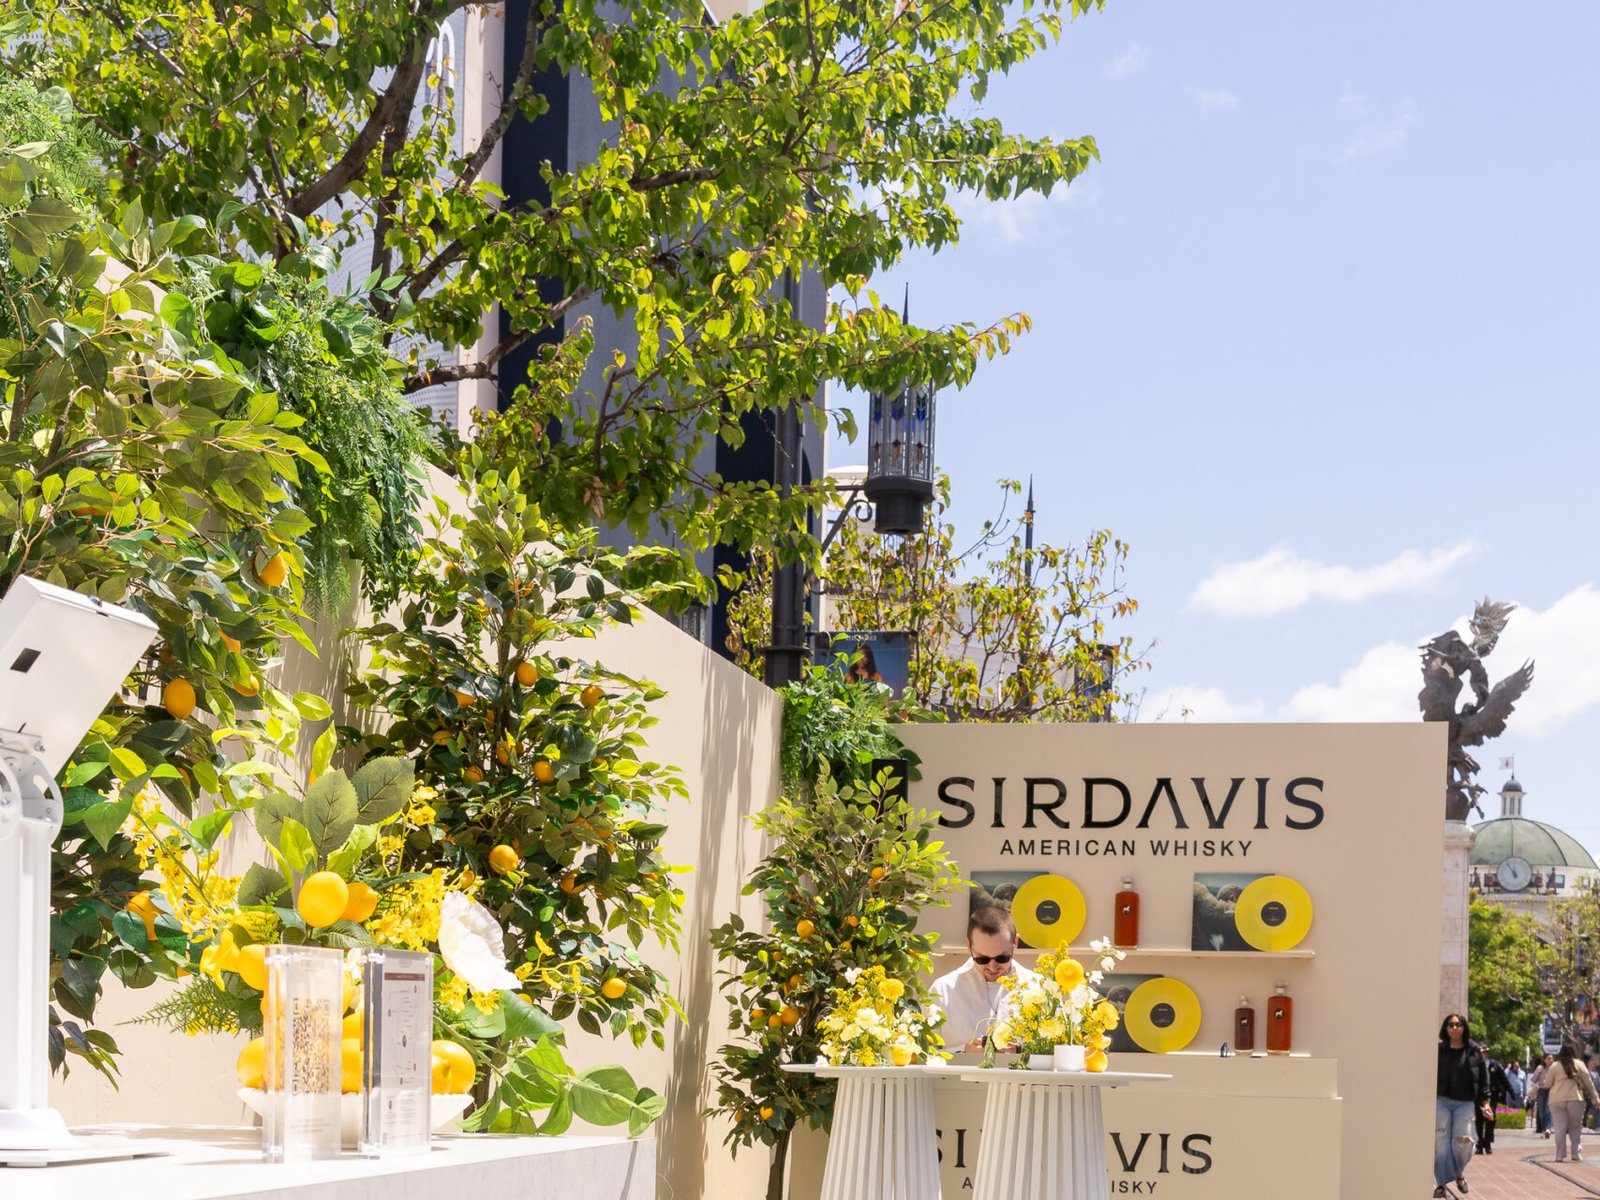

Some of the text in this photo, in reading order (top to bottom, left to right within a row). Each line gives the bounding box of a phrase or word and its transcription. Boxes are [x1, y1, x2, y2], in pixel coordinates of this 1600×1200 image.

[937, 776, 1325, 830] SIRDAVIS
[1000, 839, 1253, 857] AMERICAN WHISKY
[1110, 1179, 1158, 1194] ISKY
